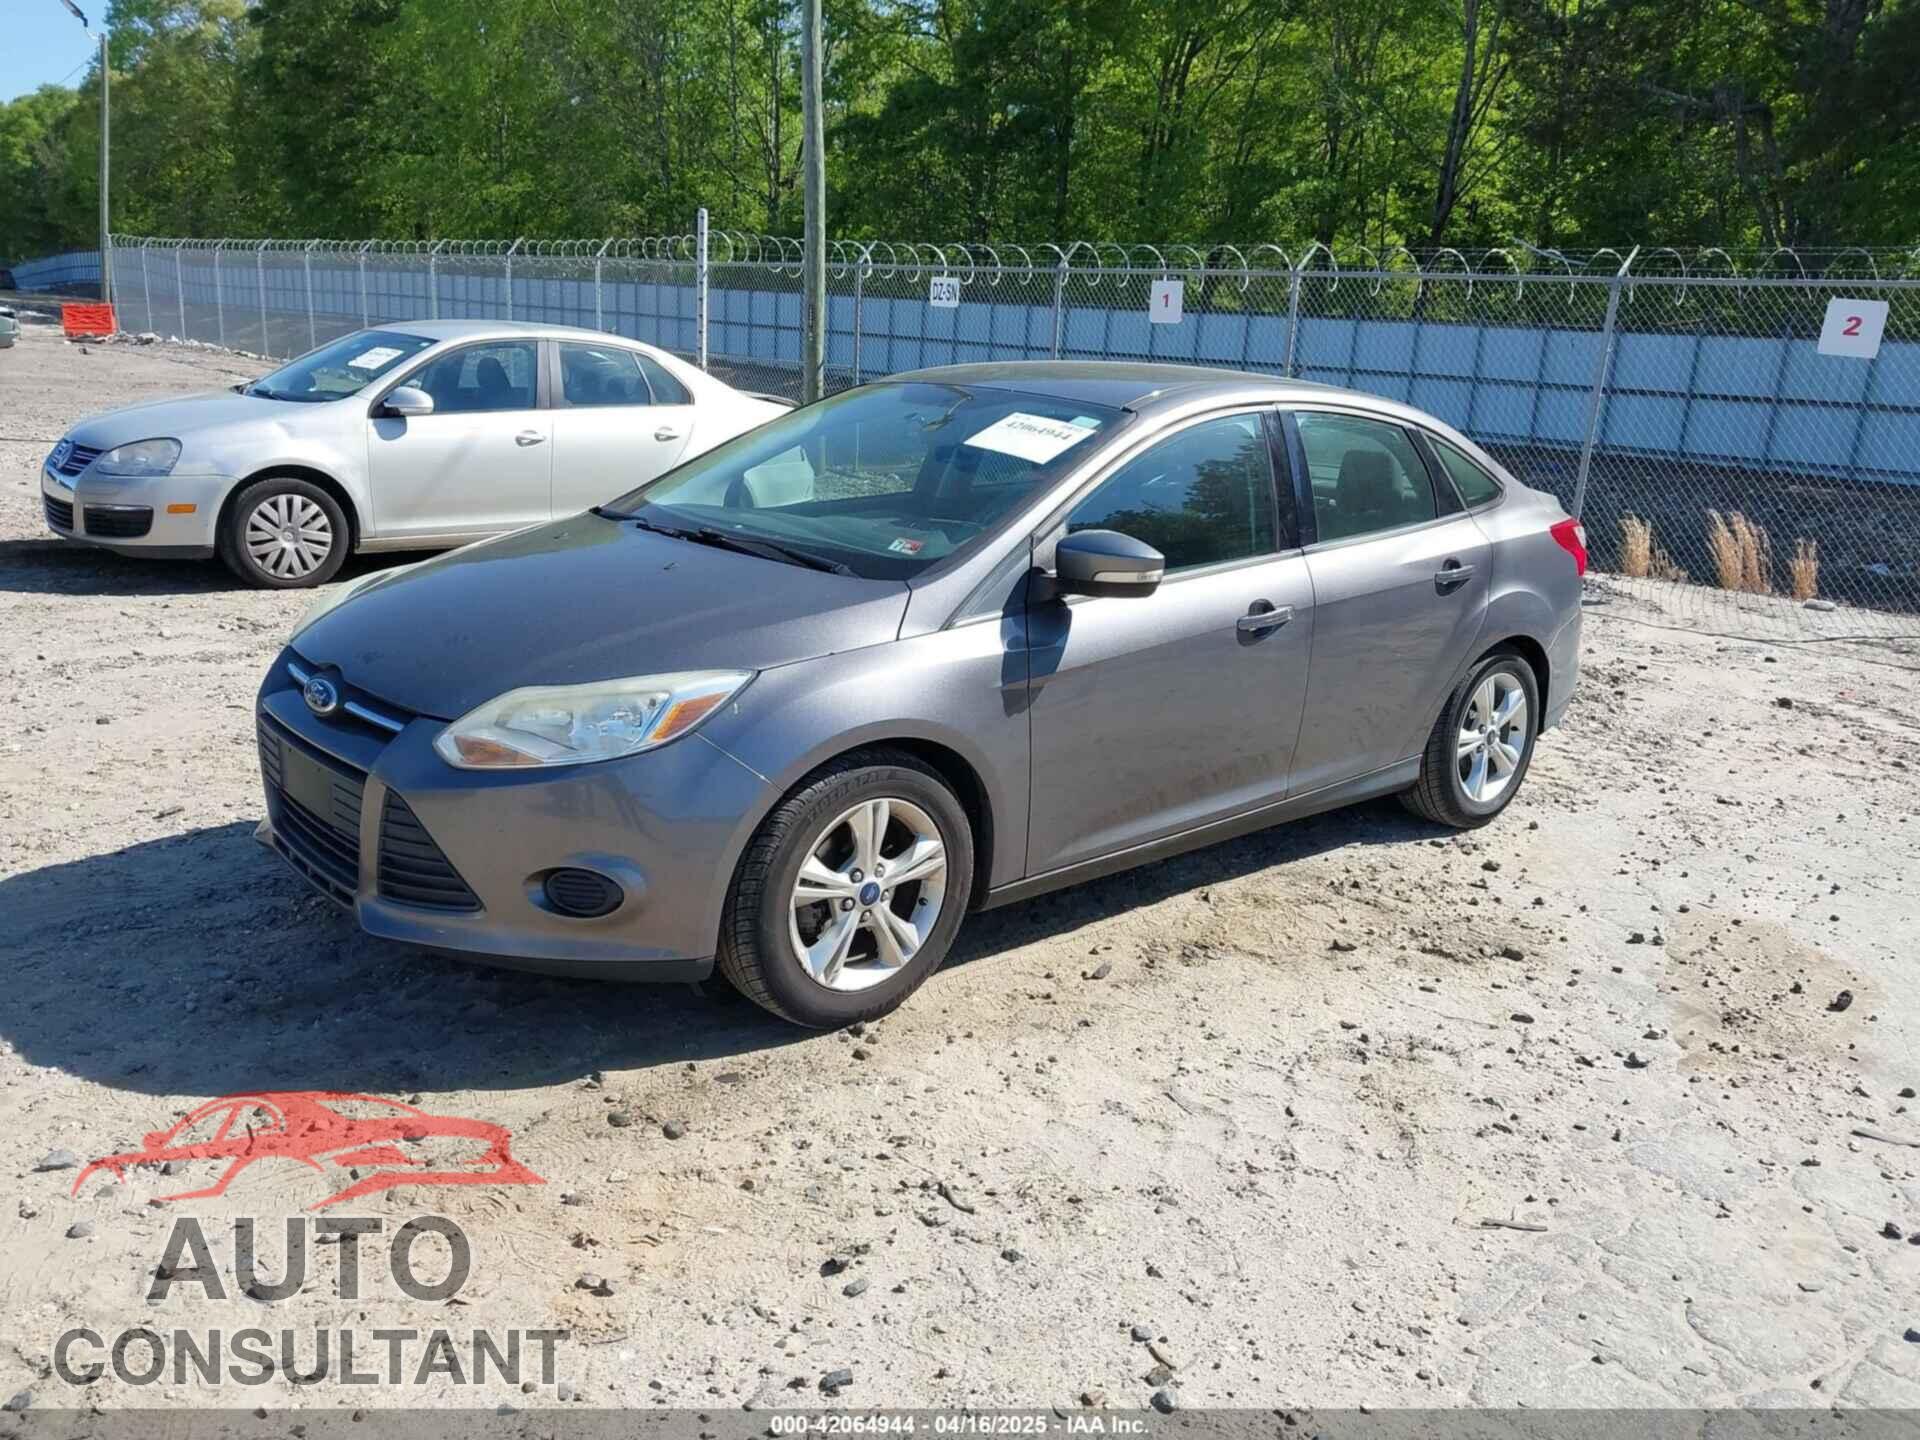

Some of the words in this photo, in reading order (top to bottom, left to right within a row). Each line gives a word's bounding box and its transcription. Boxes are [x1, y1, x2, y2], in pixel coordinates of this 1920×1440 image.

[932, 282, 958, 302] DZ-SN
[1162, 293, 1169, 308] 1
[1842, 316, 1863, 336] 2
